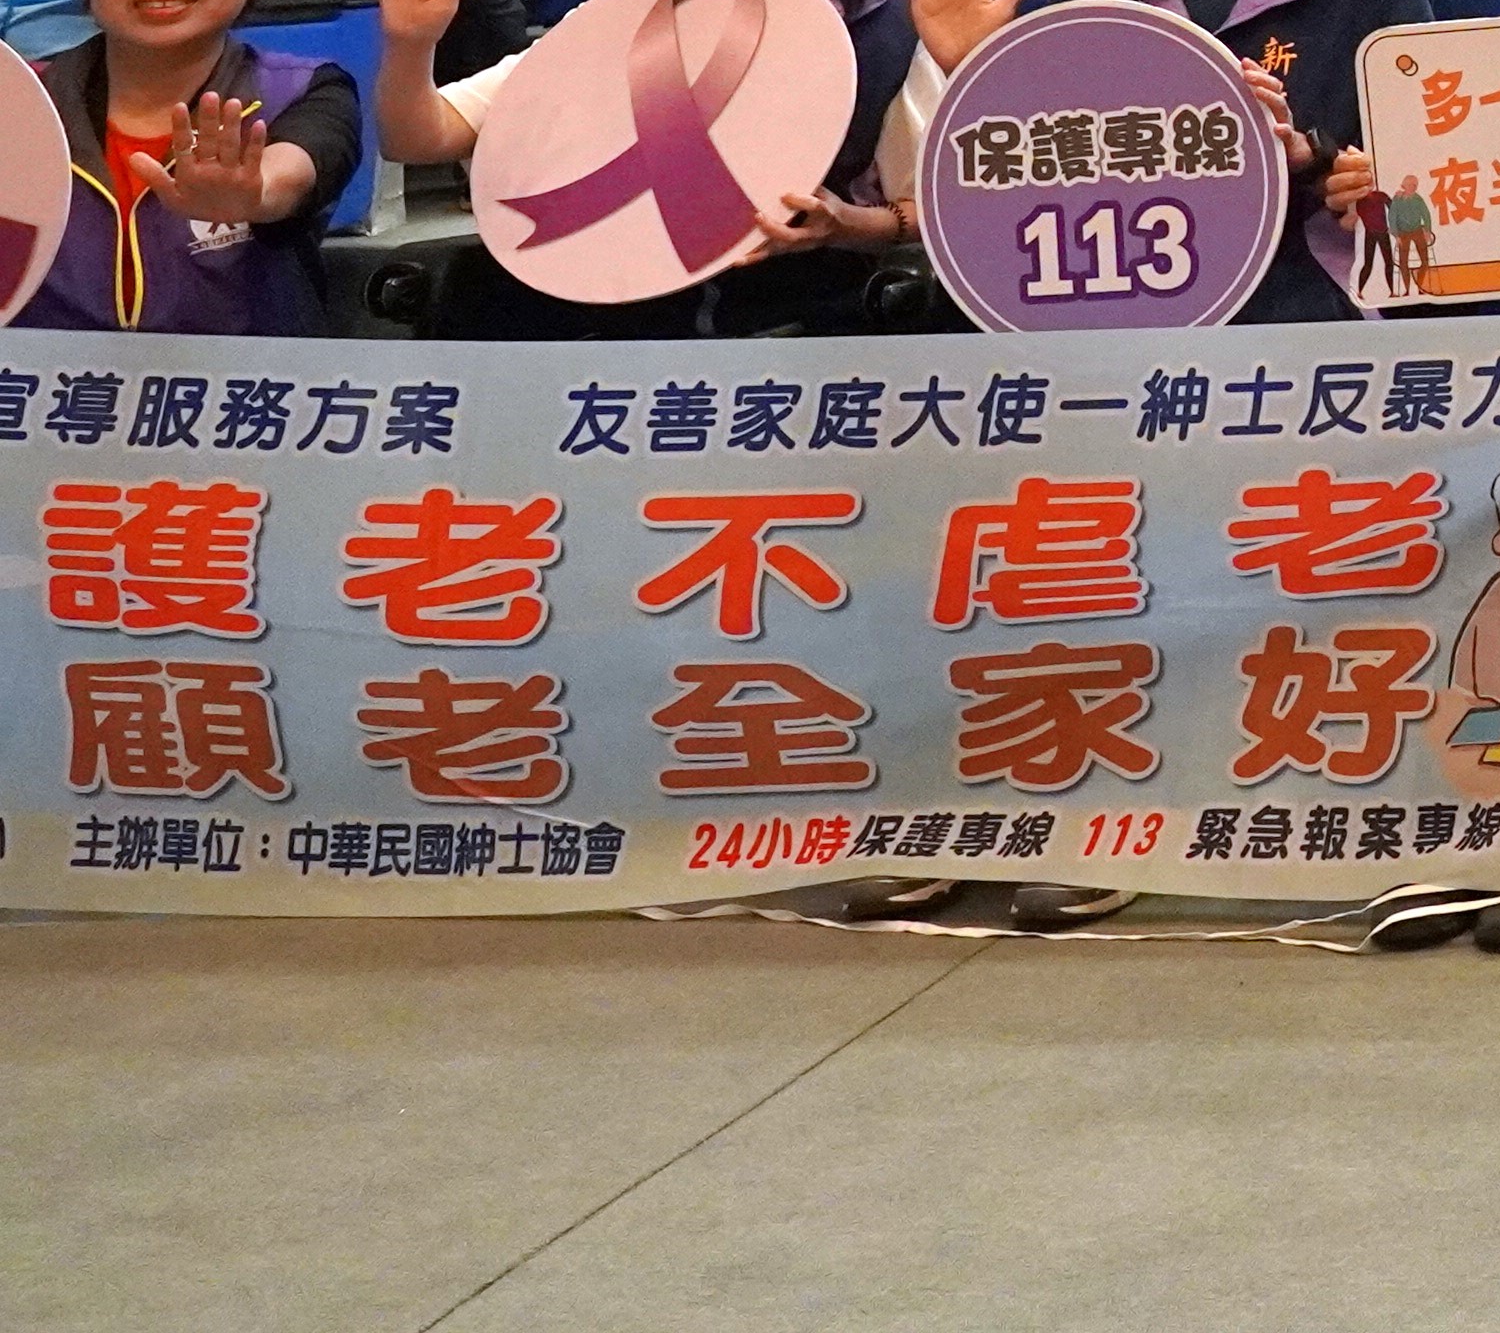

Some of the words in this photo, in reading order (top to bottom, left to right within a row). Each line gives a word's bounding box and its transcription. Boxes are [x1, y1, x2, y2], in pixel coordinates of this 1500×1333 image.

[1260, 37, 1297, 75] 新
[955, 106, 1242, 185] 保護專線
[1022, 206, 1194, 298] 113
[44, 470, 1444, 642] 護老不虐老
[69, 627, 1437, 800] 顧老全家好
[70, 815, 626, 878] 主辦單位：中華民國紳士協會
[1084, 811, 1160, 857] 113
